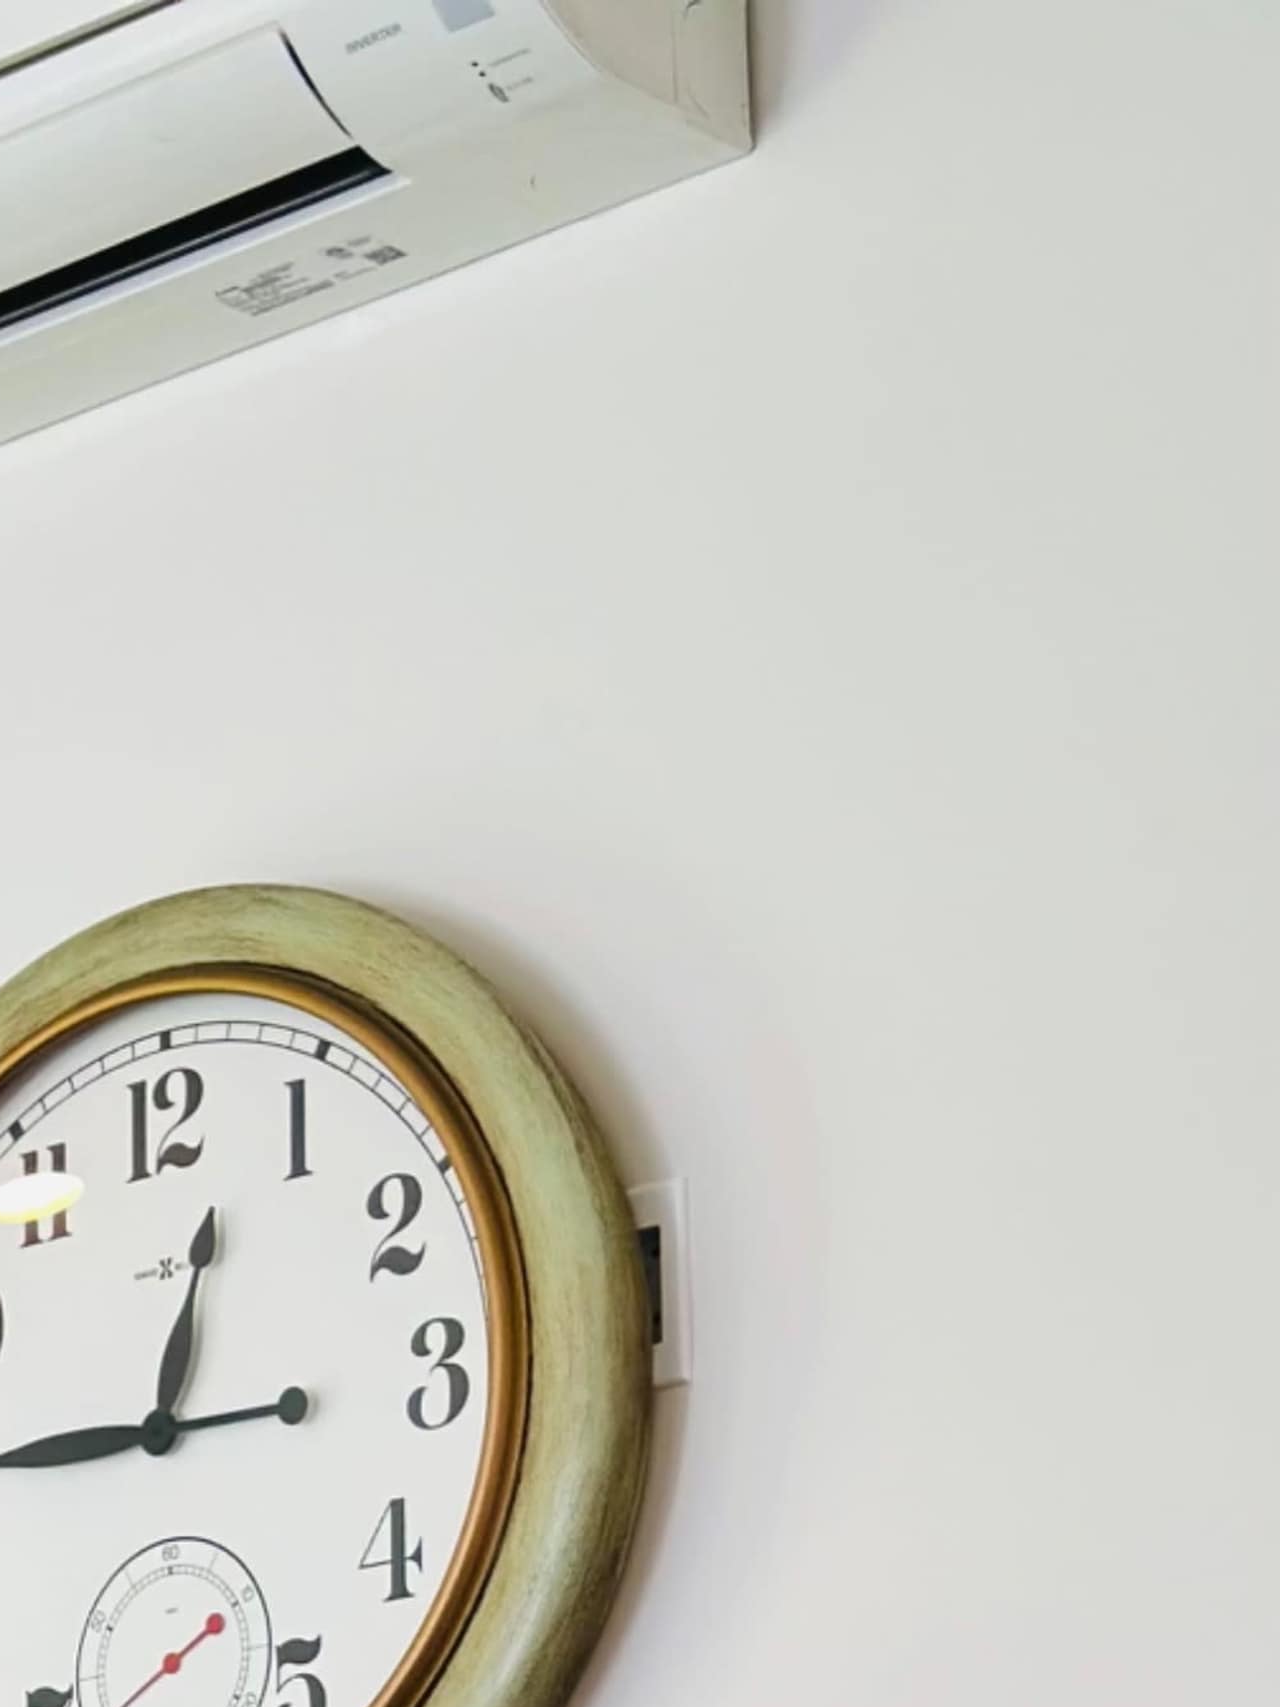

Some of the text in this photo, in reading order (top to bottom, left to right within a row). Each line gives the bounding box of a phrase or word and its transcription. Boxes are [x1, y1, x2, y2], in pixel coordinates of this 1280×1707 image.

[345, 23, 401, 54] INVERTER
[126, 1067, 206, 1182] 12
[283, 1079, 311, 1181] 1
[20, 1143, 72, 1248] 11
[367, 1172, 427, 1282] 2
[407, 1316, 470, 1429] 3
[161, 1544, 181, 1561] 60
[359, 1498, 425, 1602] 4
